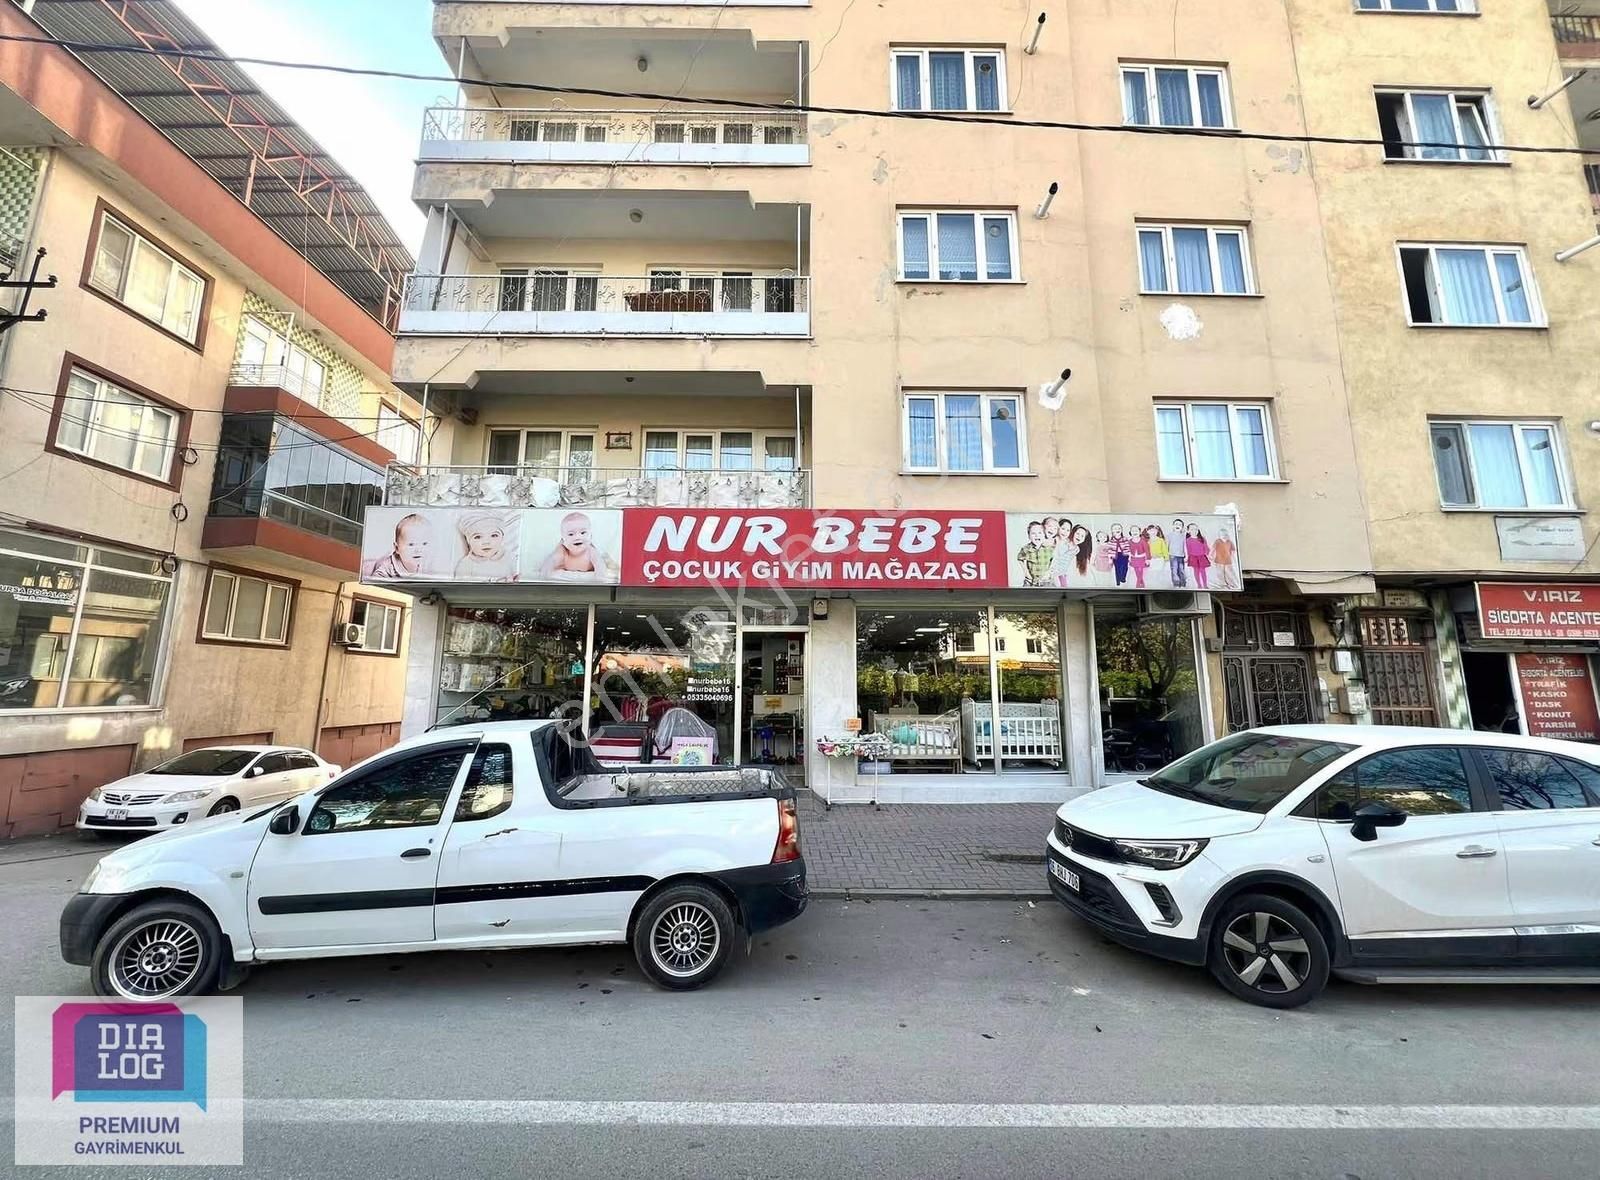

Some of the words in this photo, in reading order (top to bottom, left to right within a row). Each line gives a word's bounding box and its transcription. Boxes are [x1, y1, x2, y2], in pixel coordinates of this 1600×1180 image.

[644, 515, 788, 556] NUR
[810, 517, 983, 555] BEBE
[643, 561, 742, 582] ÇOCUK
[842, 558, 987, 580] MAĞAZASI
